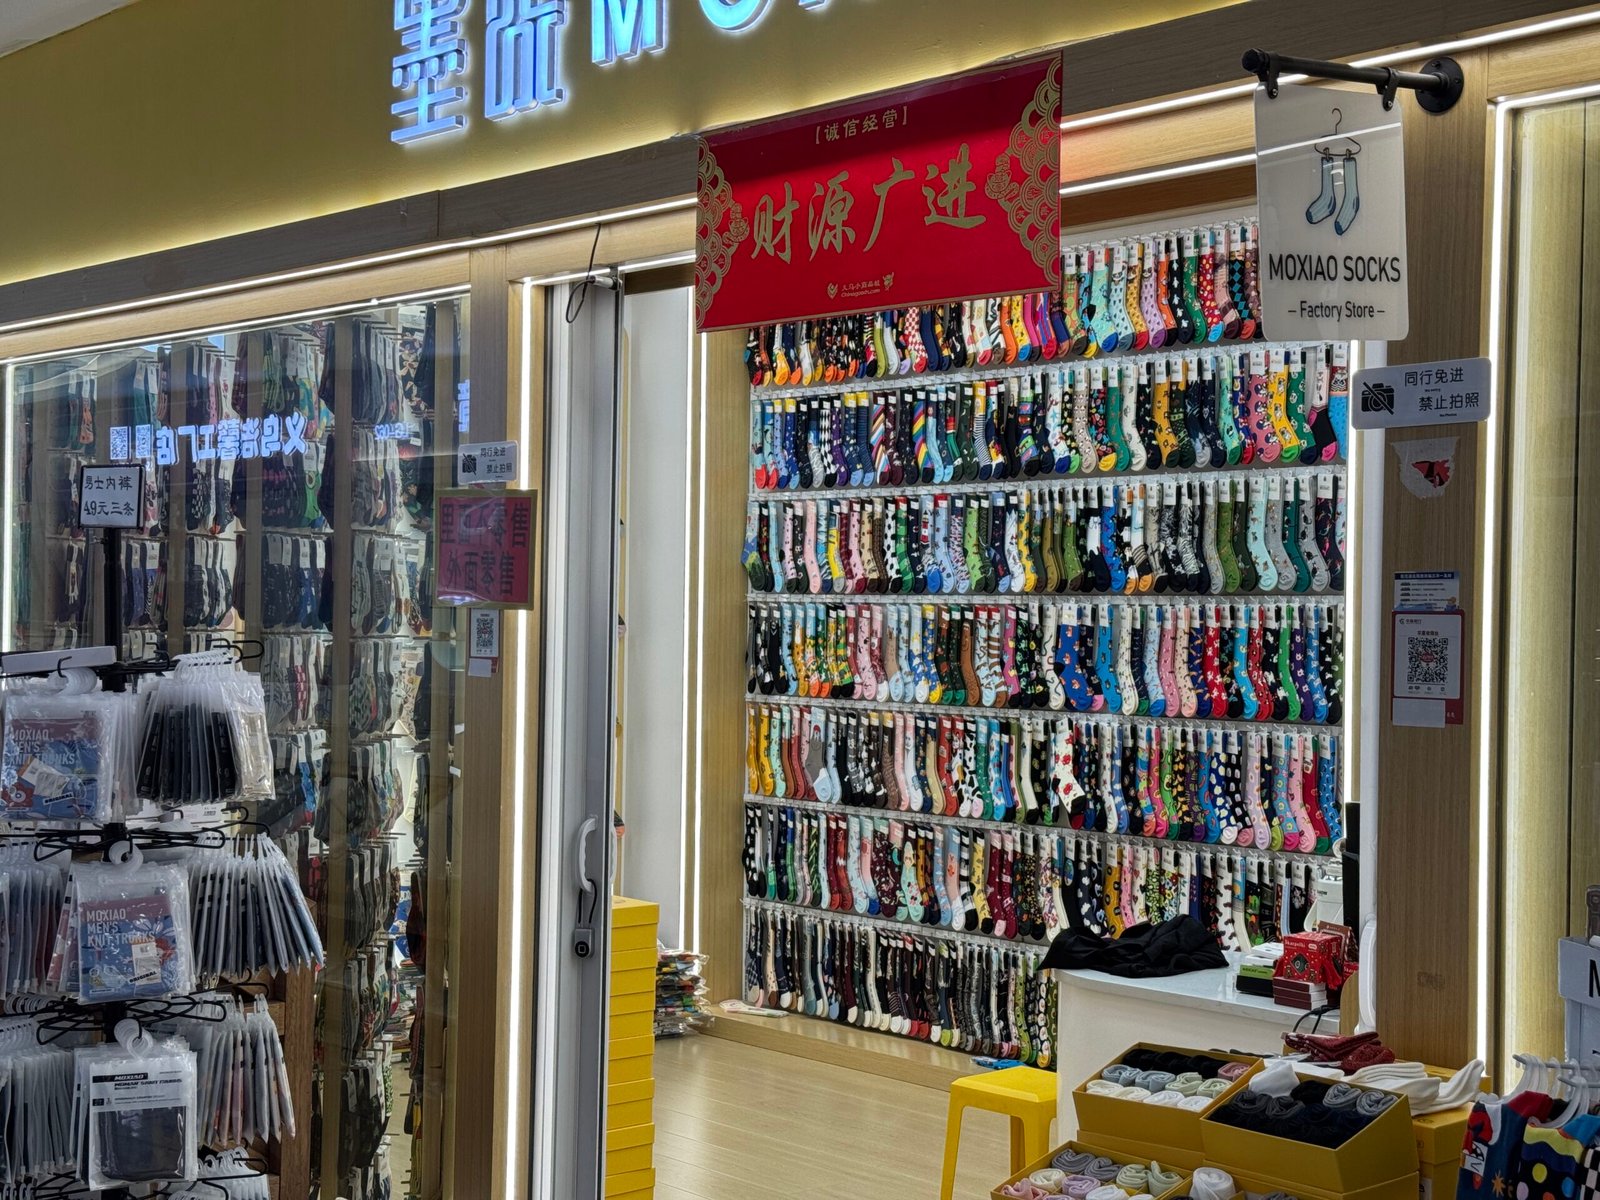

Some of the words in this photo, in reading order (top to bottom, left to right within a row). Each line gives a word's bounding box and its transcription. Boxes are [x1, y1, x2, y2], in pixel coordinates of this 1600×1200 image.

[751, 143, 986, 265] 财源广进
[1269, 253, 1339, 283] MOXIAO
[1343, 255, 1402, 283] SOCKS
[1299, 300, 1342, 322] Factory
[1345, 301, 1375, 319] Store
[1404, 367, 1464, 388] 同行免进
[1418, 391, 1480, 412] 禁止拍照
[83, 501, 135, 517] 49元三条
[446, 550, 515, 597] 外面零售
[86, 908, 127, 923] MOXIAO
[87, 922, 119, 935] MEN'S
[88, 934, 113, 948] KNIT
[115, 931, 156, 946] TRUNKS
